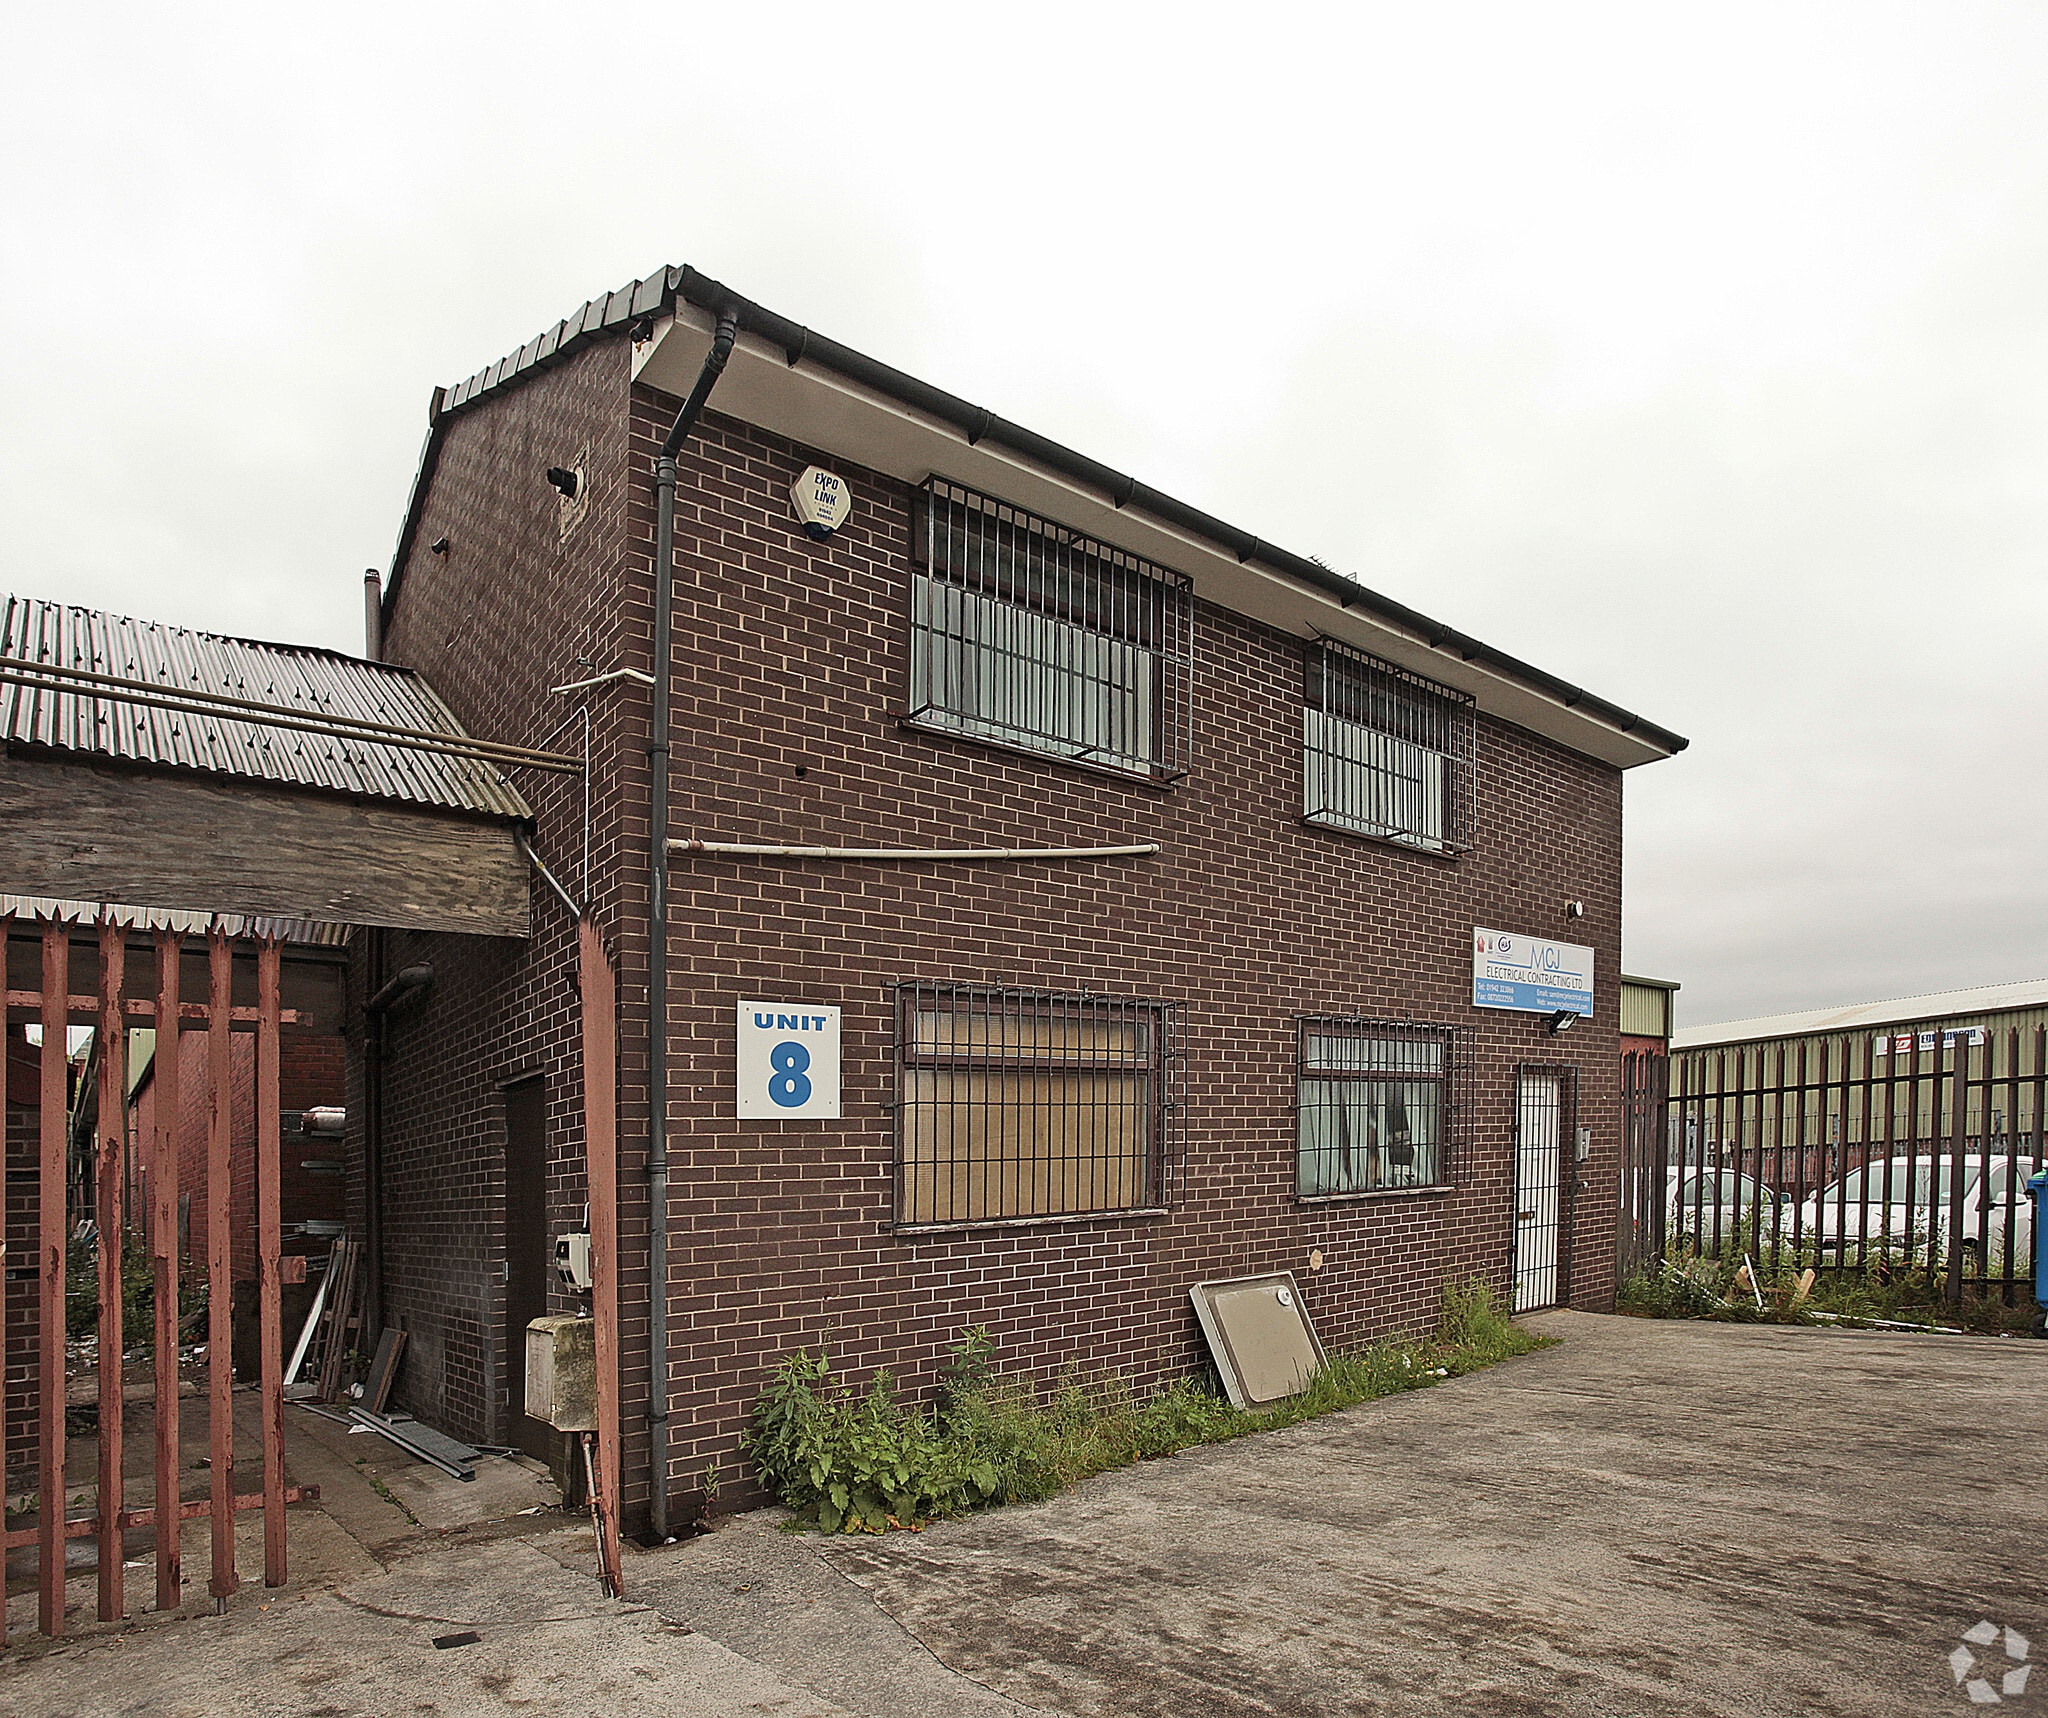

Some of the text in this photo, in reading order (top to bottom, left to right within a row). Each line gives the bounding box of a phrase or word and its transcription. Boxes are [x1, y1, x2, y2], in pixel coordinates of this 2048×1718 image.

[815, 472, 839, 491] EXPO
[814, 489, 837, 506] LINK
[1531, 944, 1560, 970] MCJ
[1486, 965, 1583, 990] ELECTRICAL CONTRACTING LTD
[754, 1012, 827, 1032] UNIT
[768, 1041, 812, 1108] 8
